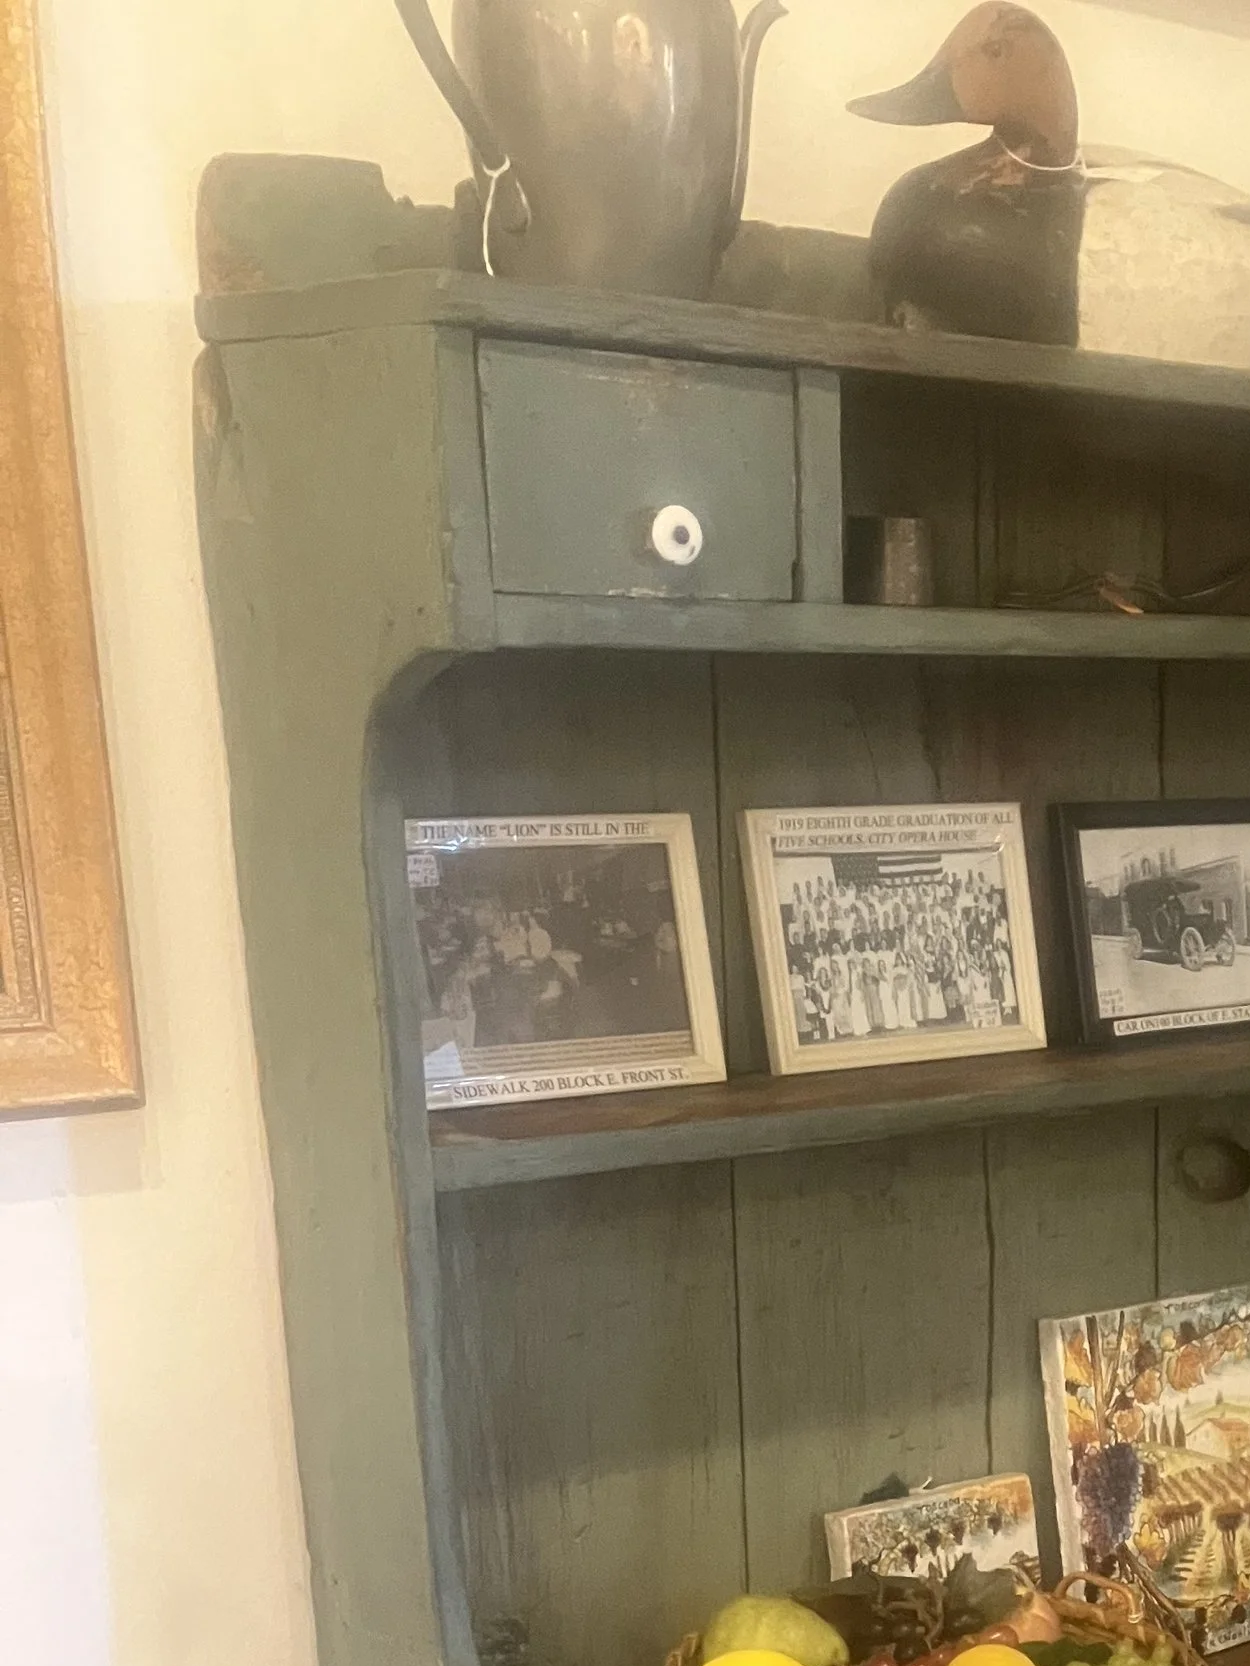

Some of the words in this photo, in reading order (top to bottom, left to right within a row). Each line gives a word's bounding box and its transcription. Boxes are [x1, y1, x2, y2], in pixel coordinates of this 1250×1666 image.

[421, 825, 448, 839] THE
[453, 824, 497, 839] NAME
[550, 823, 562, 837] IS
[565, 823, 603, 837] STILL
[606, 822, 620, 836] IN
[624, 821, 649, 836] THE
[779, 817, 804, 831] 1919
[806, 816, 851, 830] EIGHTH
[853, 815, 895, 828] GRADE
[896, 813, 973, 828] GRADUATION
[974, 812, 991, 826] OF
[992, 811, 1014, 824] ALL
[778, 834, 805, 848] FIVE
[868, 832, 895, 845] CITY
[898, 830, 937, 844] OPERA
[1117, 1020, 1138, 1033] CAR
[454, 1080, 529, 1099] SIDEWALK
[534, 1078, 555, 1092] 200
[558, 1074, 604, 1090] BLOCK
[621, 1069, 665, 1085] FRONT
